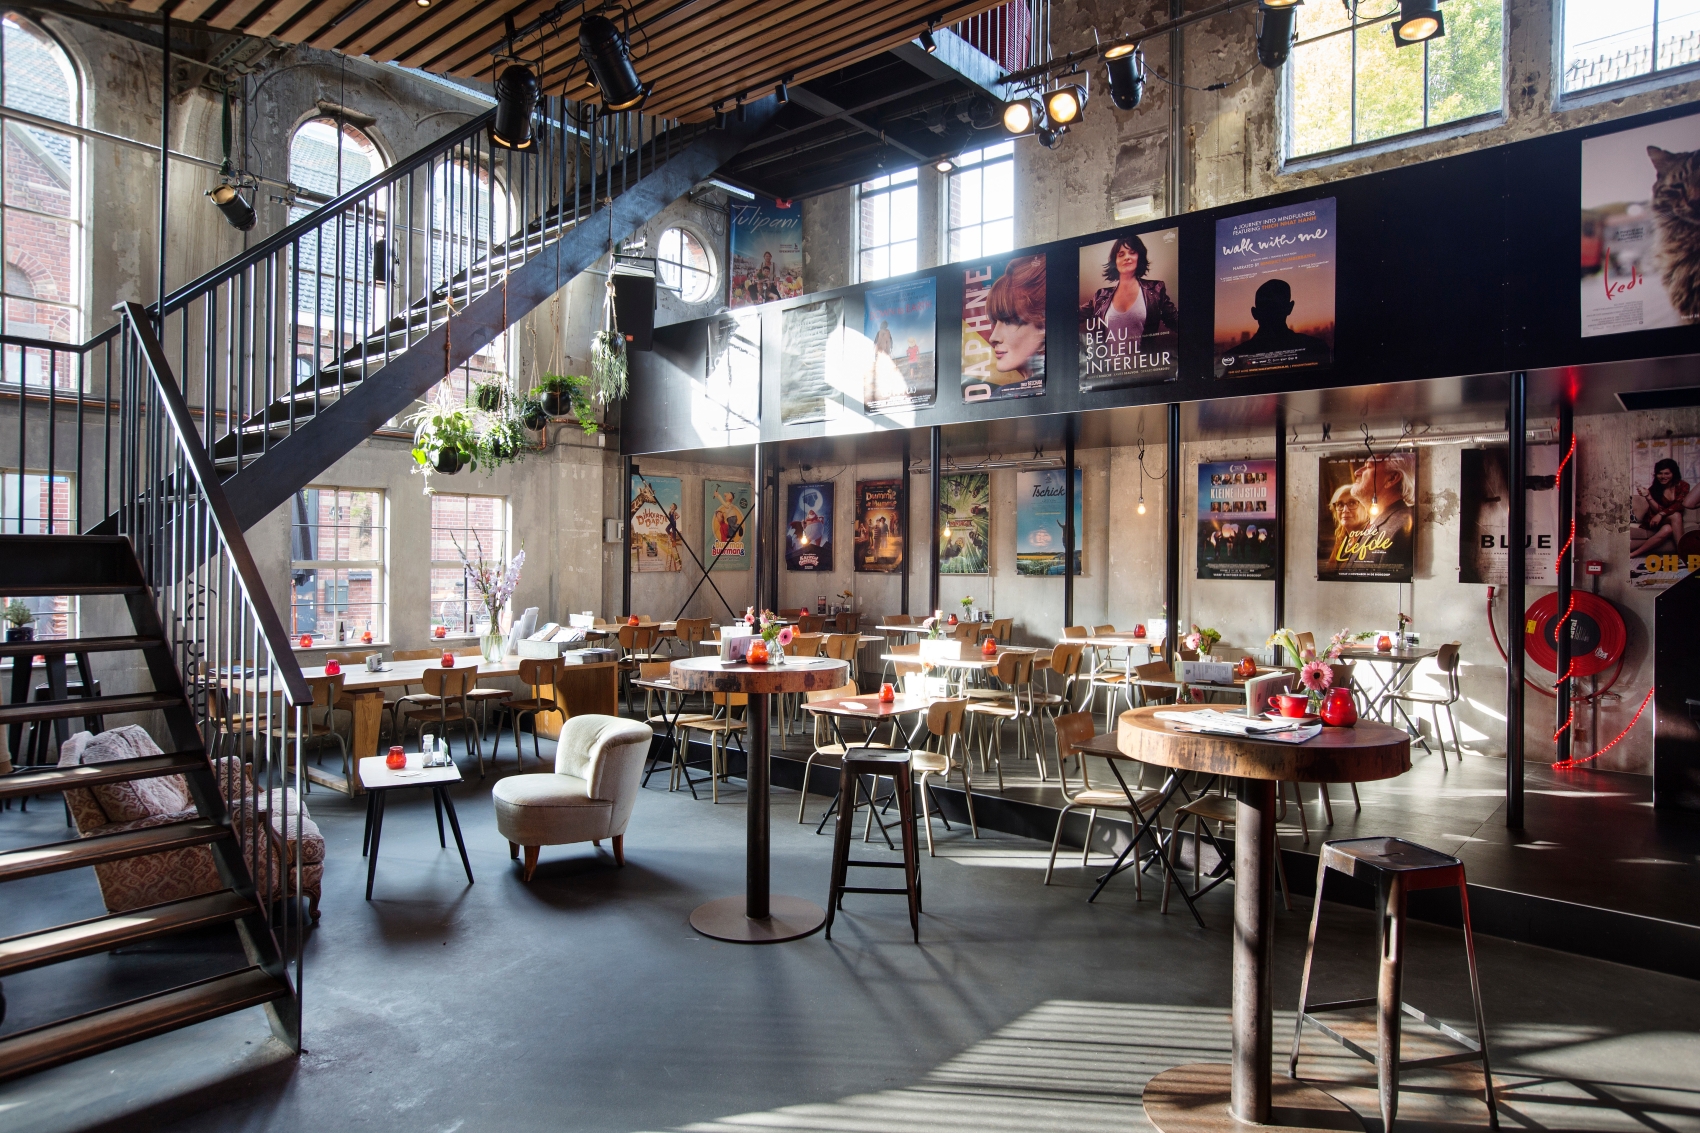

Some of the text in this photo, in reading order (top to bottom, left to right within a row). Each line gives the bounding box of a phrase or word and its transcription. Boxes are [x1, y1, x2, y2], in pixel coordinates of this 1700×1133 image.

[731, 204, 800, 234] Tulipani
[1232, 226, 1261, 236] FEATURING
[1280, 219, 1296, 227] NHAT
[1298, 215, 1317, 224] HANH
[1239, 220, 1262, 229] JOURNEY
[1278, 210, 1316, 222] MINDFULNESS
[1222, 228, 1328, 256] walk with me
[906, 300, 933, 313] EARTH
[1086, 317, 1109, 331] UN
[964, 265, 992, 403] DAPHNE
[1086, 327, 1128, 346] BEAU
[1086, 340, 1141, 360] SOLEIL
[1086, 351, 1171, 375] INTÉRIEUR
[1032, 485, 1066, 498] Tschick
[1210, 486, 1267, 499] KLEINE IJSTIJD
[1349, 524, 1379, 538] oude
[1336, 530, 1393, 562] Liefde
[1645, 554, 1679, 572] OH
